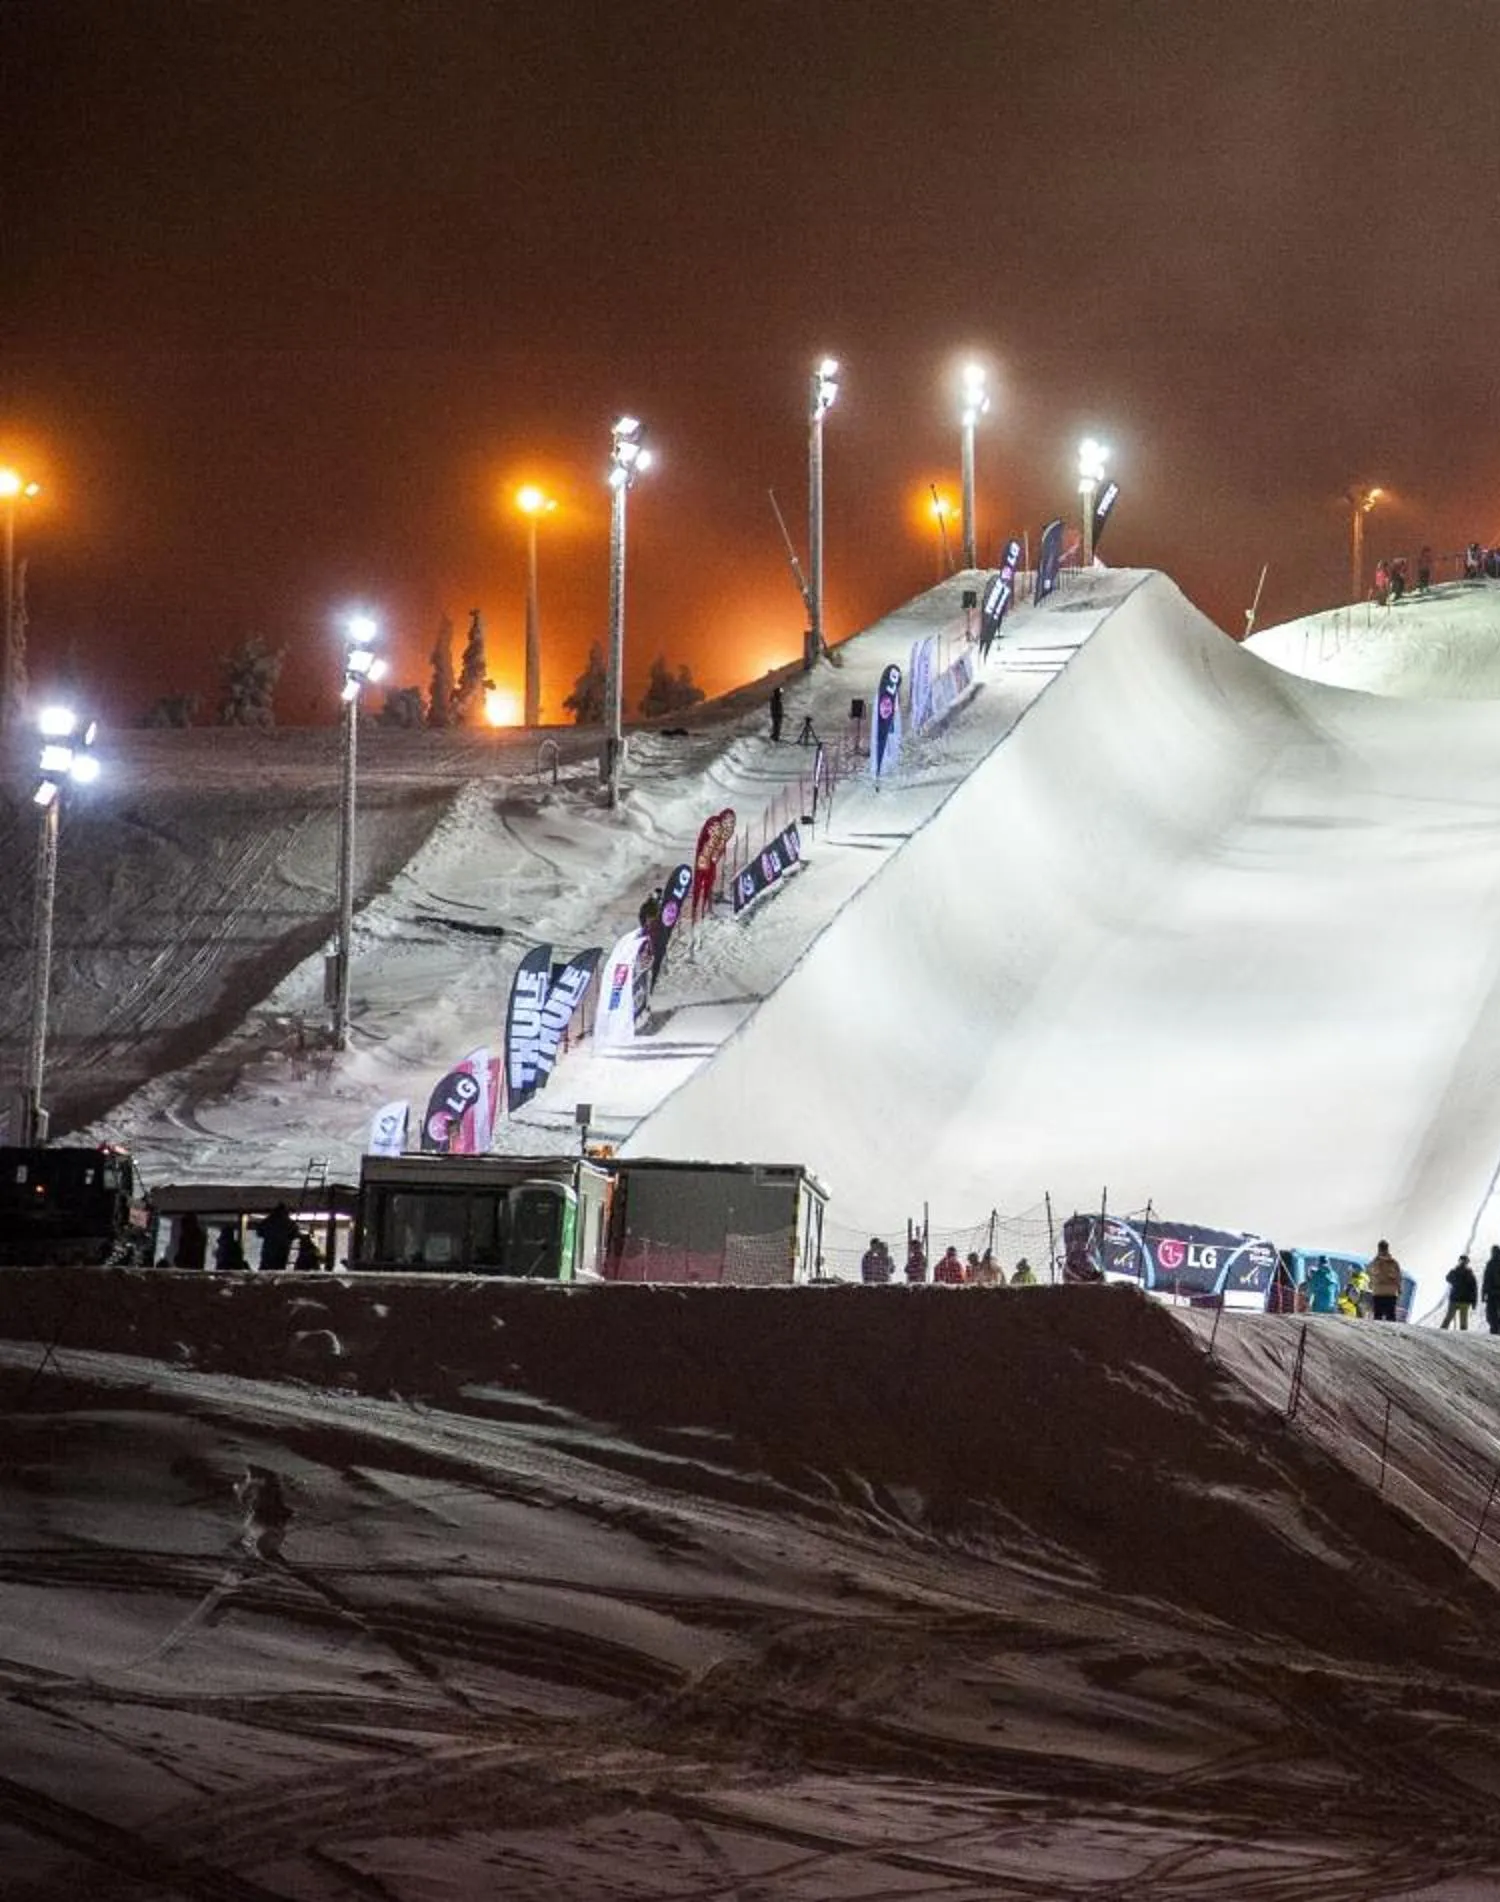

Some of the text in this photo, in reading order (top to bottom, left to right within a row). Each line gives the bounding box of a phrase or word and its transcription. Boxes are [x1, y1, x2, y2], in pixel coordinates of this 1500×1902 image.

[886, 668, 899, 695] LG
[673, 868, 691, 898] LG
[511, 969, 549, 1088] THULE
[446, 1078, 478, 1113] LG
[1187, 1245, 1217, 1268] LG
